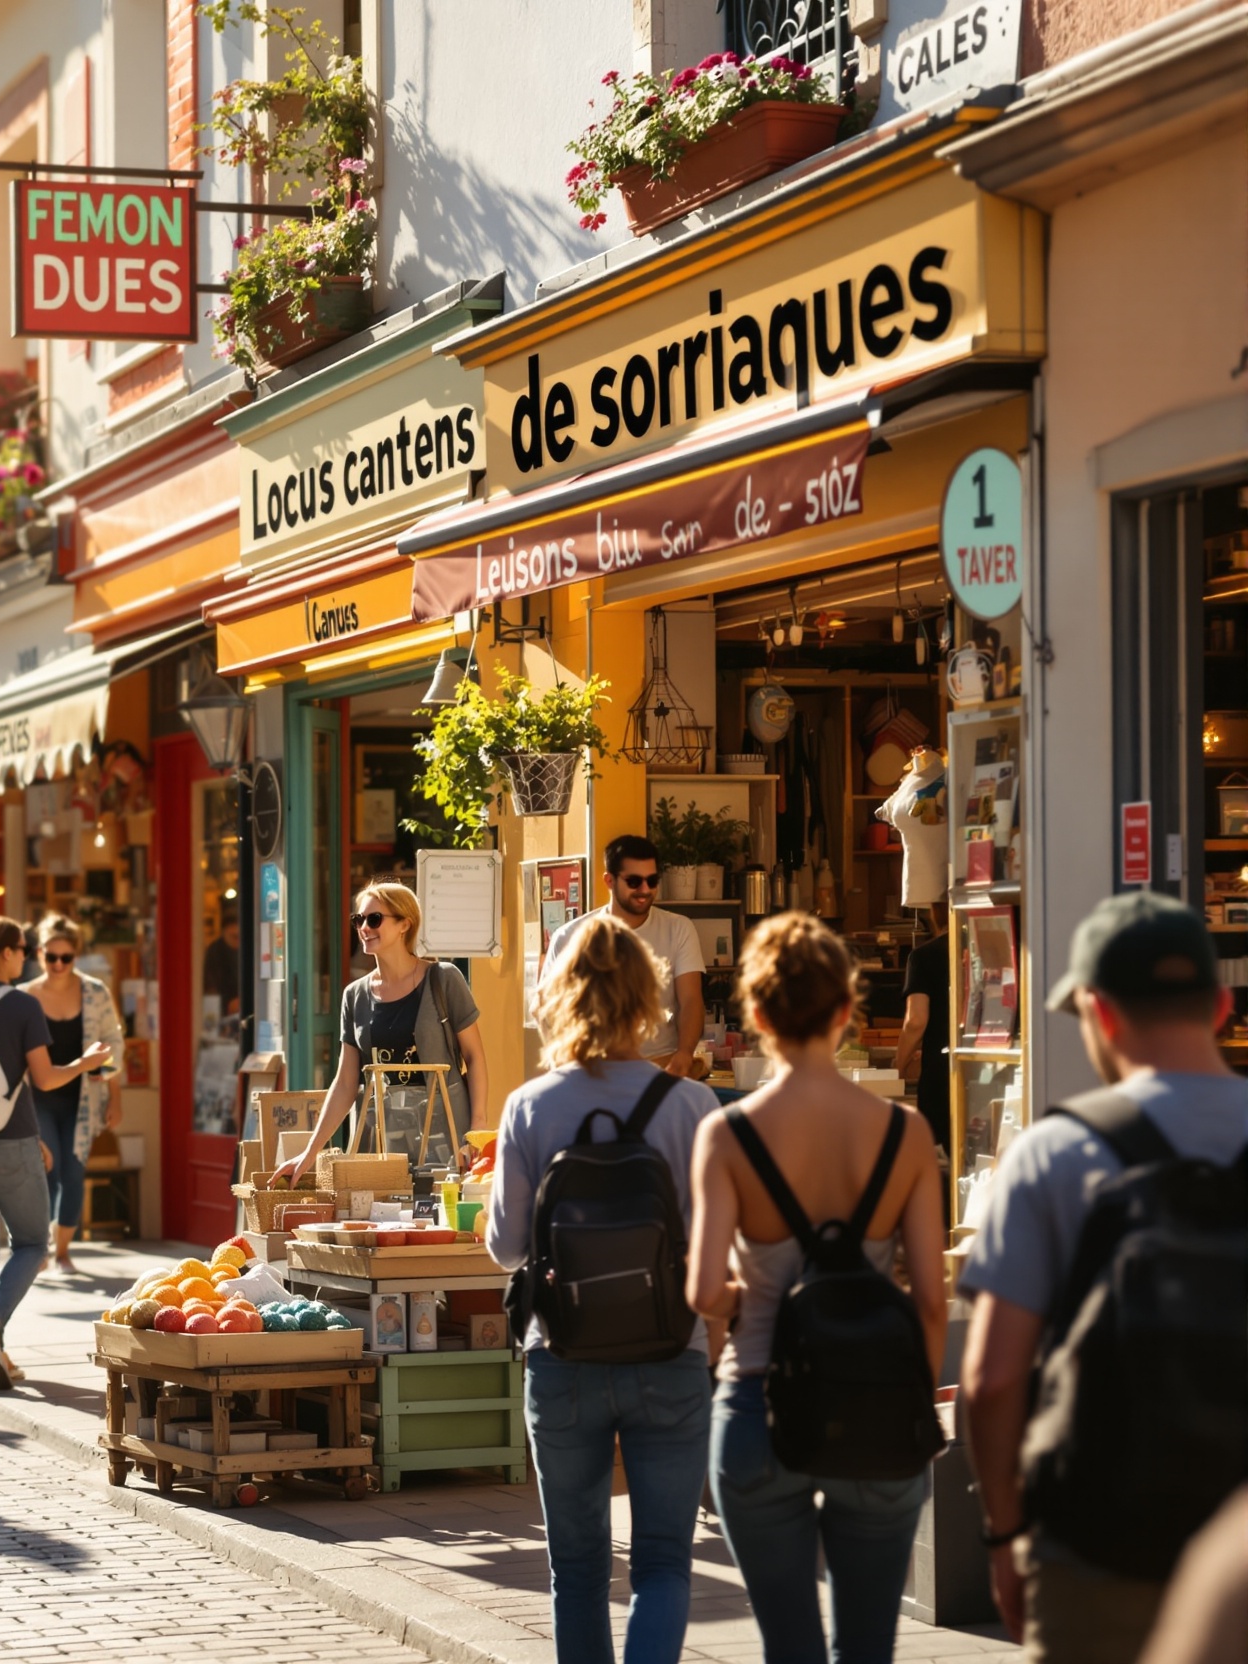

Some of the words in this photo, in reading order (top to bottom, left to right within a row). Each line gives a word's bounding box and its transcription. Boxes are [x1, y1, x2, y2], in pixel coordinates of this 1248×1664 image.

[898, 6, 988, 94] CALES
[27, 189, 183, 247] FEMON
[33, 254, 182, 314] DUES
[511, 353, 576, 473] de
[590, 246, 952, 448] sorriaques
[252, 460, 335, 541] Locus
[343, 407, 476, 507] cantens
[972, 464, 994, 529] 1
[957, 544, 1017, 586] TAVER
